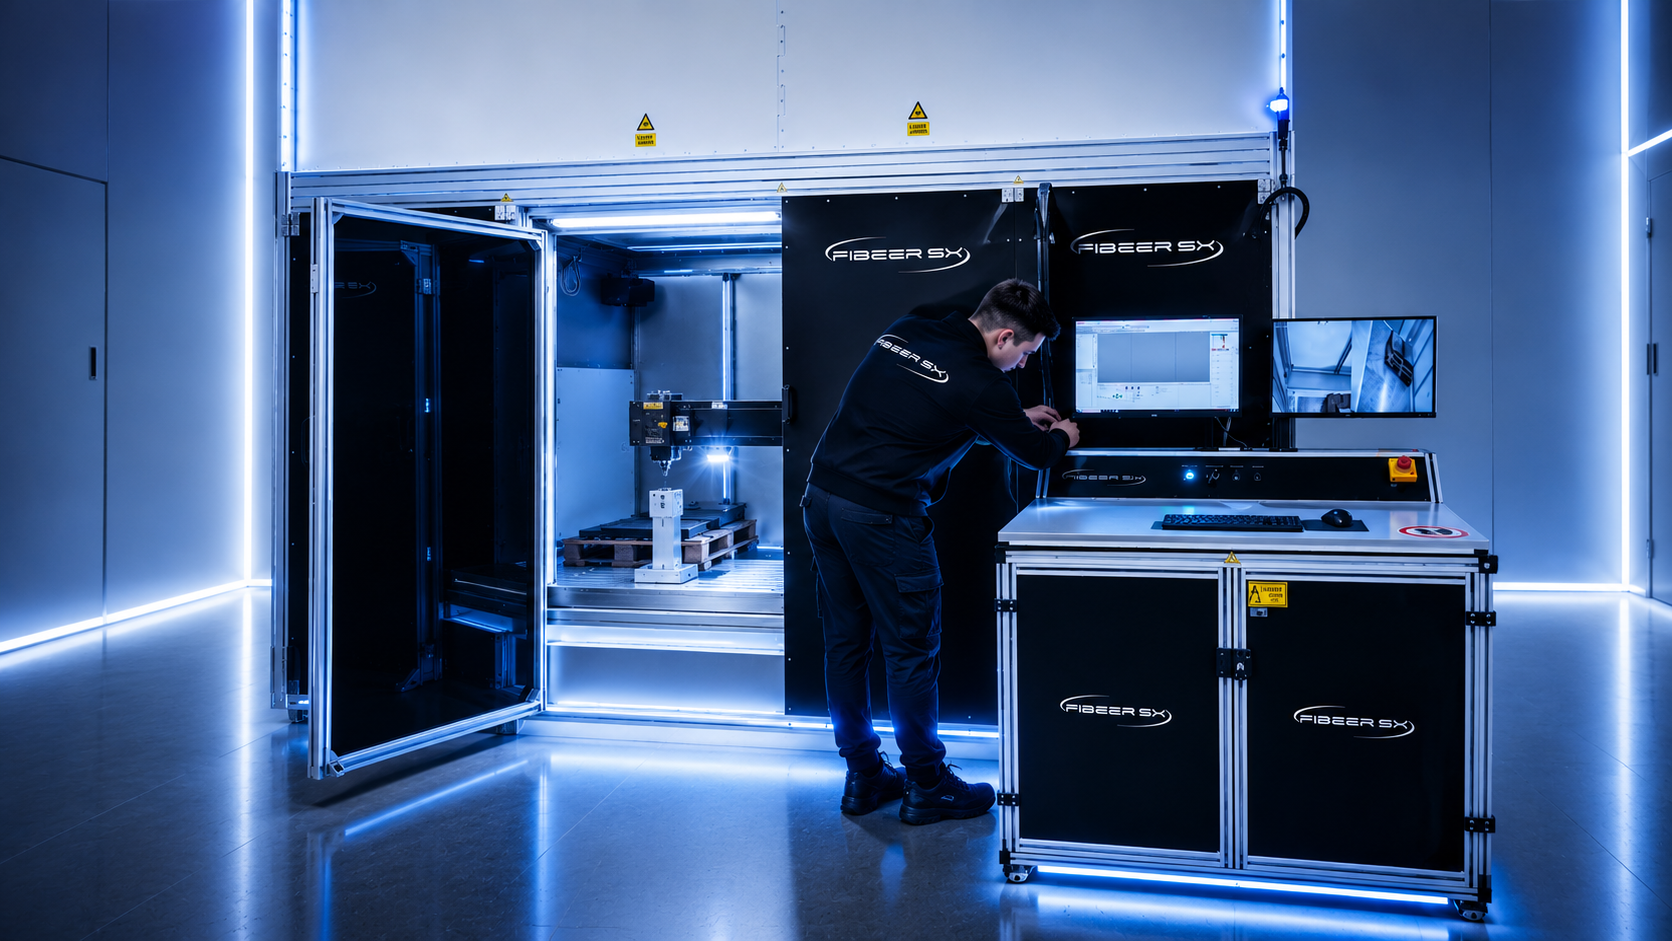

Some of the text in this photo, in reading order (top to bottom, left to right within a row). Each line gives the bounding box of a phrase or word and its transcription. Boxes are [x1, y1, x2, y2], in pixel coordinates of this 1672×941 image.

[832, 246, 963, 262] FIBEER SX
[1078, 239, 1215, 255] FIBEER SX
[920, 359, 947, 378] SX
[1065, 703, 1166, 718] FIBEER SX
[1299, 714, 1408, 730] FIBEER SX
